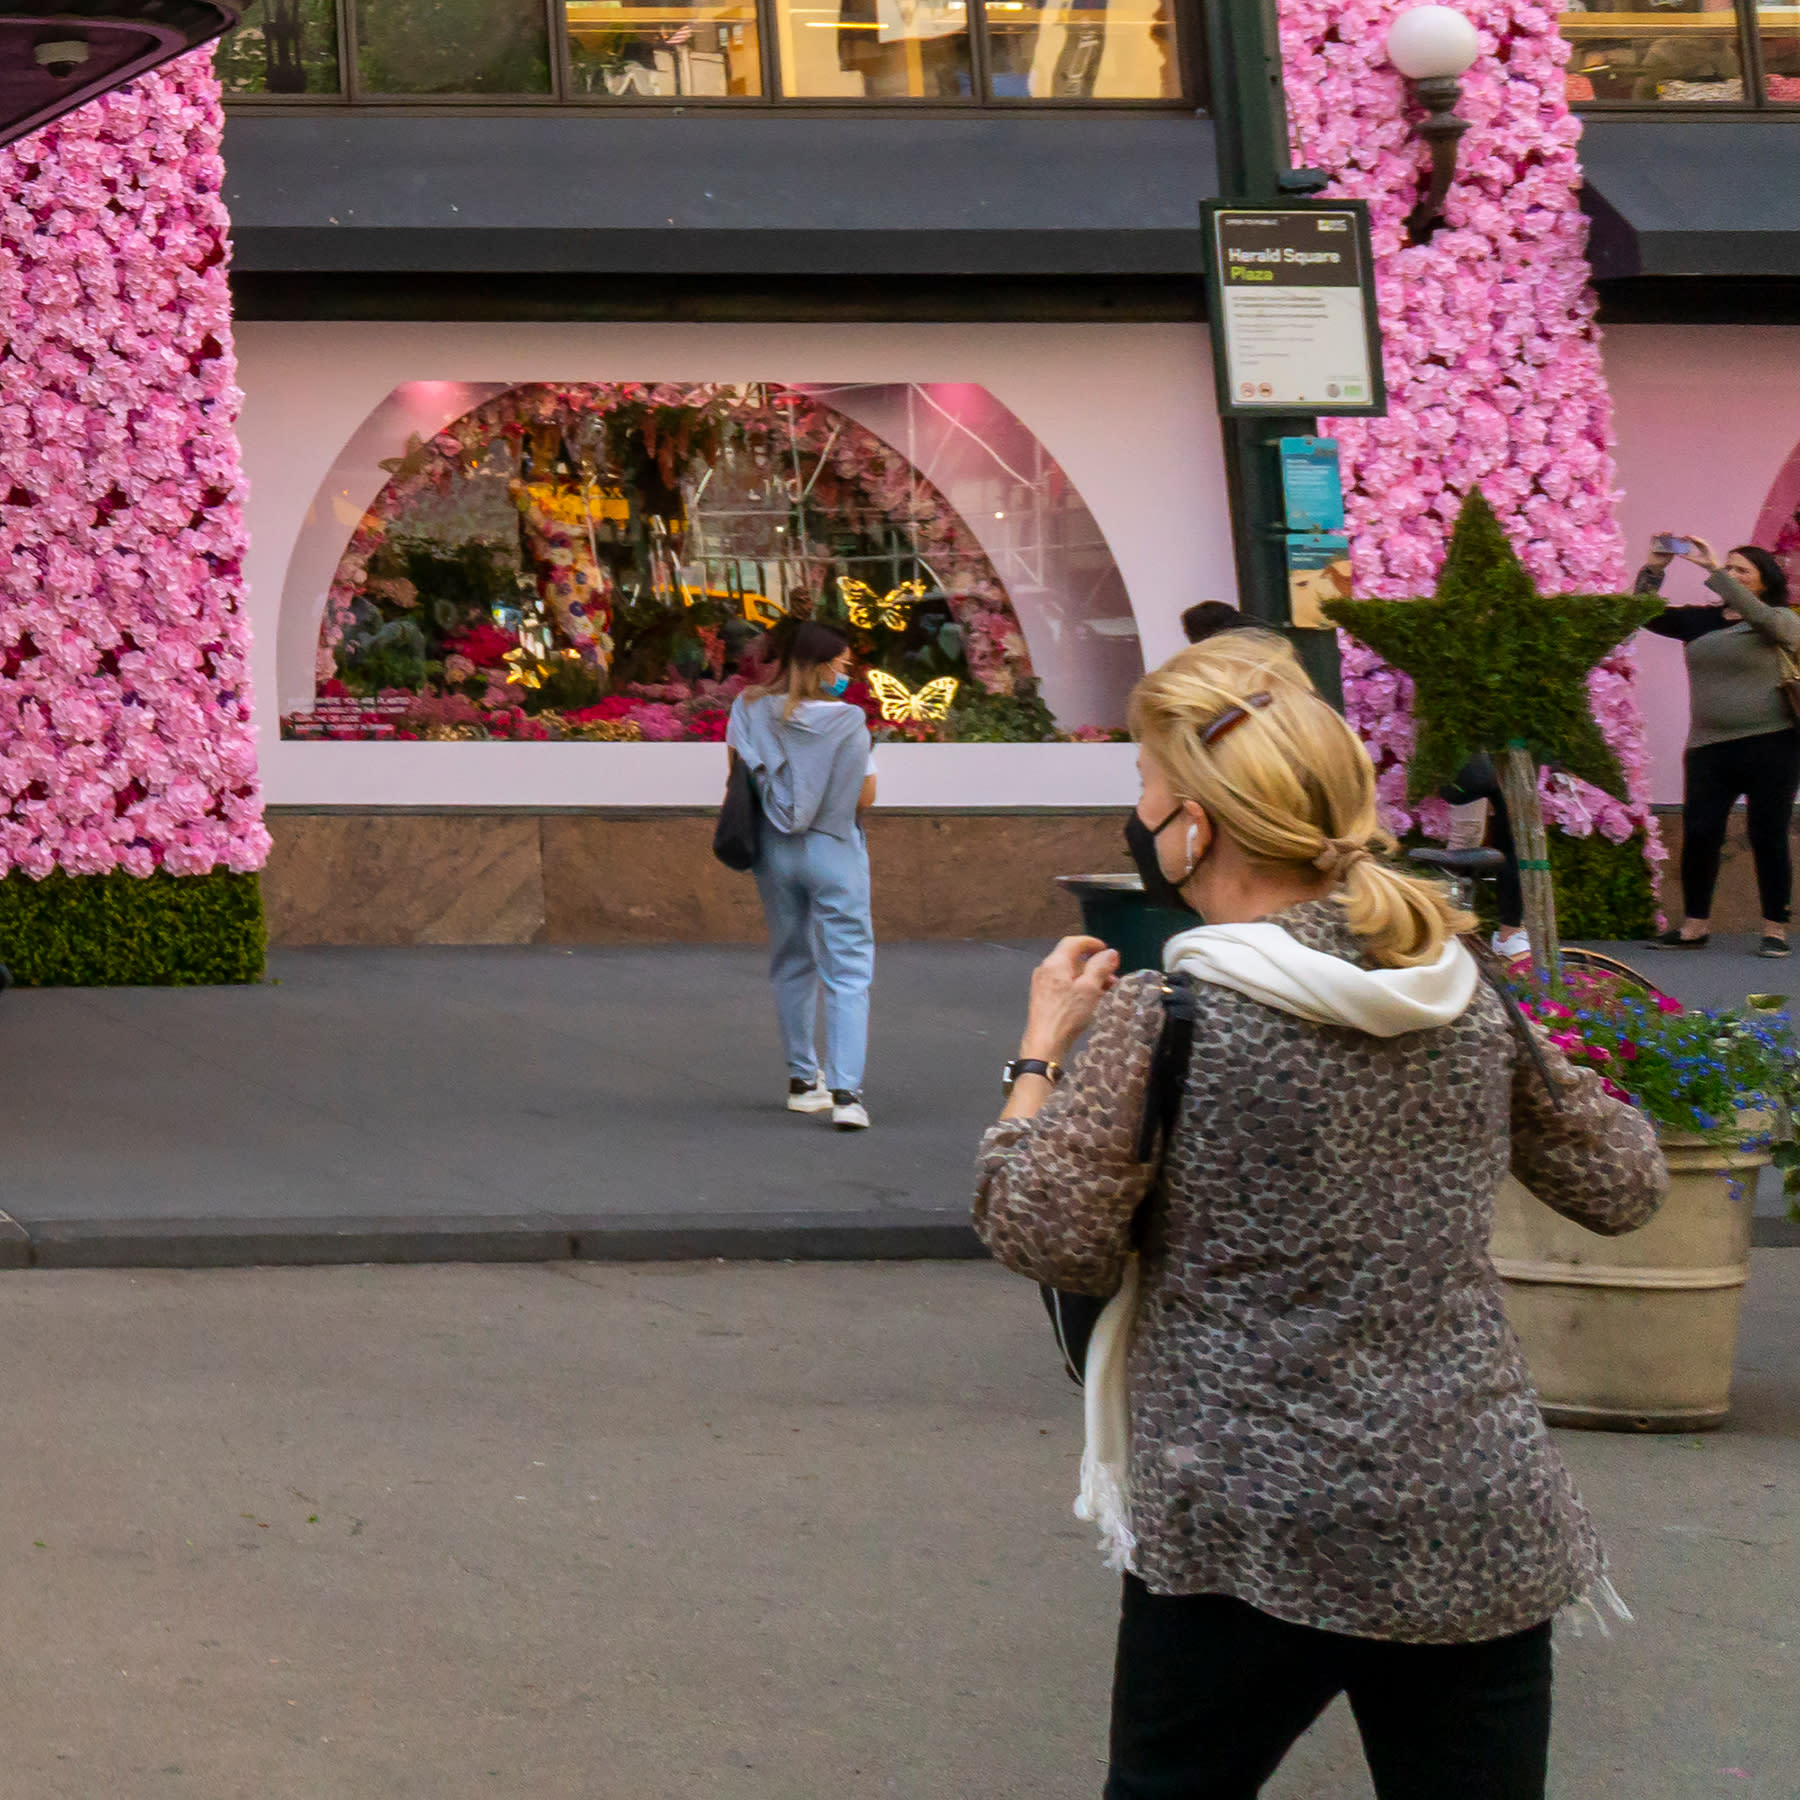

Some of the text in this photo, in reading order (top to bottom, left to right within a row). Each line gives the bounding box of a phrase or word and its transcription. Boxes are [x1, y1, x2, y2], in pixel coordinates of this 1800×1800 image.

[1228, 247, 1341, 267] Herald Square
[1230, 266, 1274, 281] Plaza
